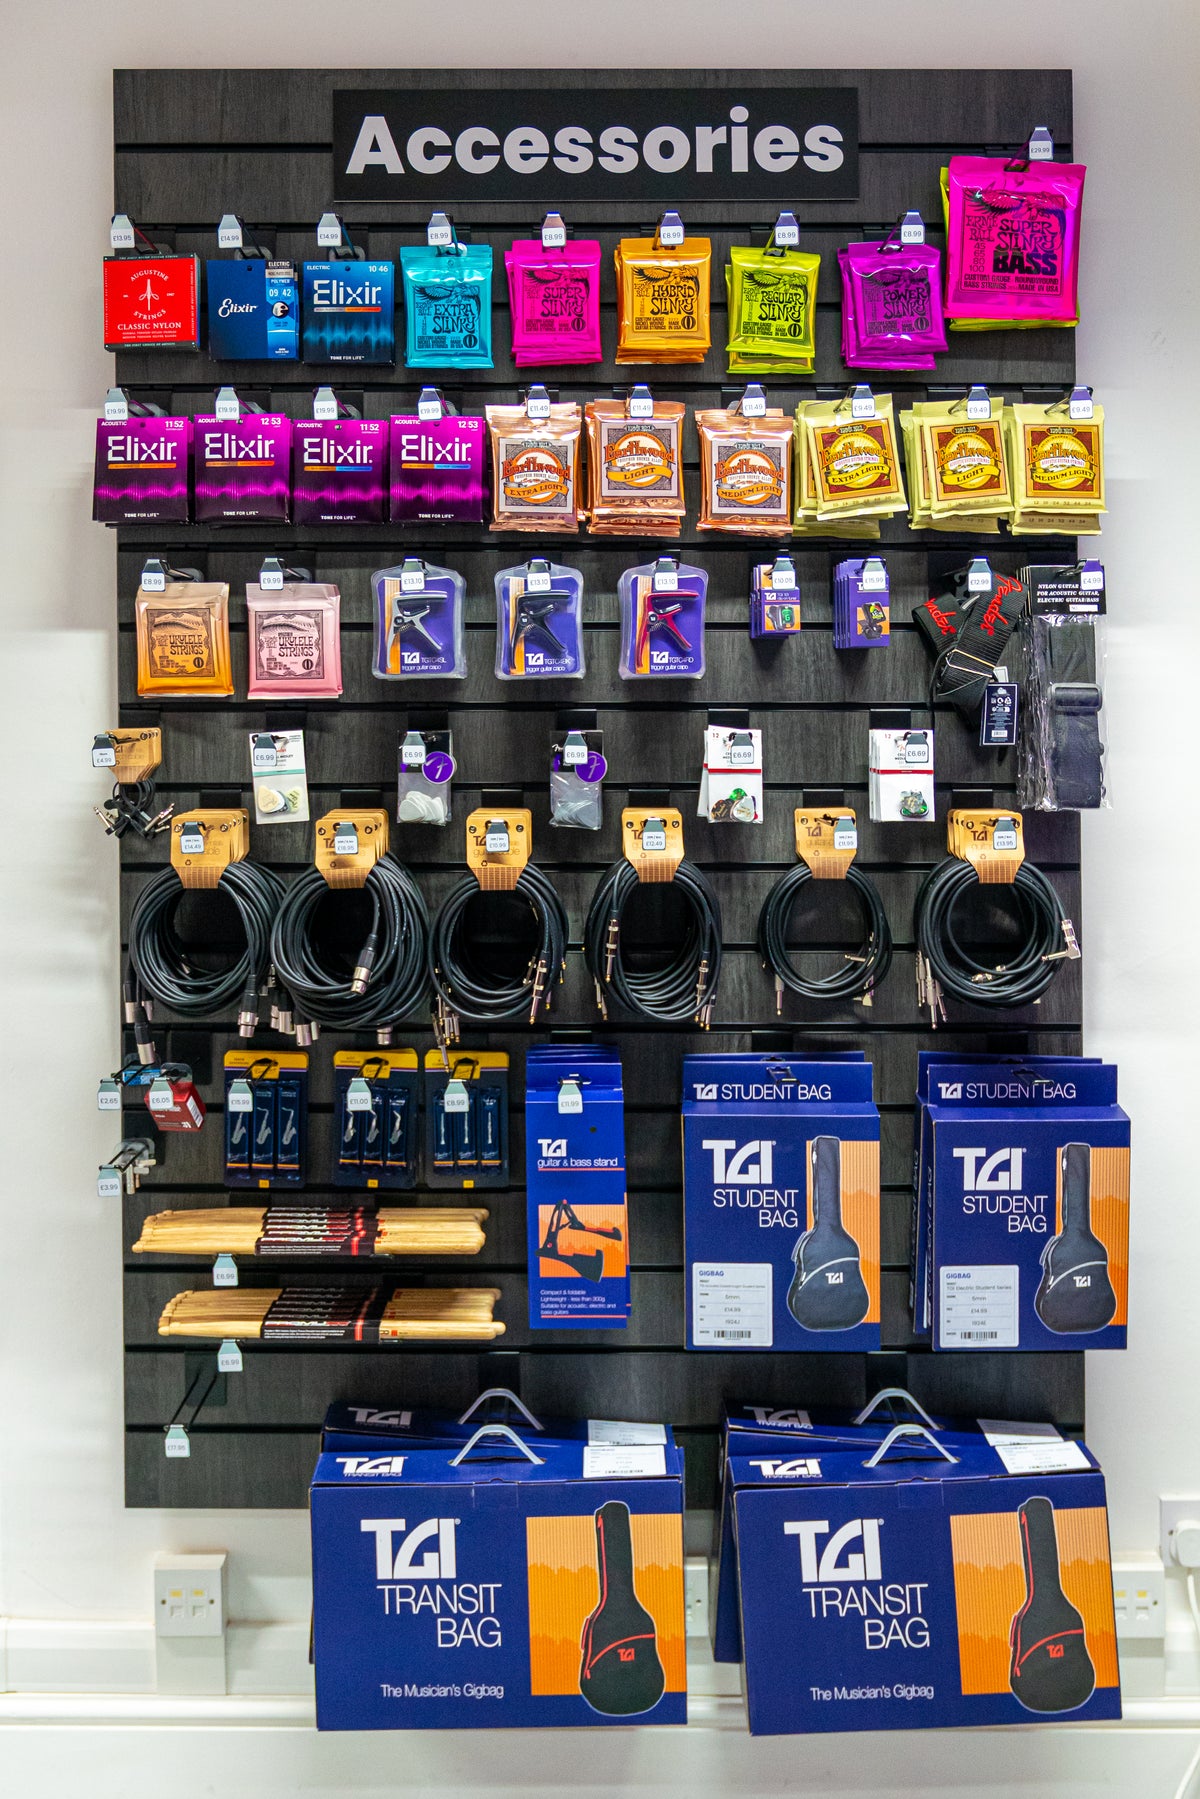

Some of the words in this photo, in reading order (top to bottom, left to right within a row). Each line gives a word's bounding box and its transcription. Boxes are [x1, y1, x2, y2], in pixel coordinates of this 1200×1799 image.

[347, 106, 845, 174] Accessories
[999, 219, 1054, 234] SUPER
[113, 234, 131, 242] £13.95
[430, 232, 448, 240] £8.99
[544, 233, 563, 241] £8.99
[662, 232, 681, 240] £8.99
[904, 230, 922, 238] £8.99
[993, 251, 1057, 274] BASS
[130, 269, 169, 282] AUGUSTINE
[964, 274, 988, 282] CUSTOM
[269, 288, 278, 297] 09
[282, 288, 291, 297] 42
[543, 286, 583, 300] SUPER
[882, 288, 926, 302] POWER
[1046, 284, 1059, 292] USA
[761, 291, 804, 306] REGULAR
[133, 308, 167, 320] STRINGS
[218, 298, 258, 318] Elixir
[434, 303, 474, 317] EXTRA
[624, 466, 656, 480] LIGHT
[831, 470, 857, 486] EXTRA
[857, 468, 885, 480] LIGHT
[957, 467, 985, 483] LIGHT
[1034, 472, 1067, 481] MEDIUM
[1069, 469, 1093, 479] LIGHT
[509, 487, 538, 498] EXTRA
[540, 485, 563, 494] LIGHT
[721, 487, 755, 498] MEDIUM
[756, 486, 781, 496] LIGHT
[169, 634, 203, 645] UKULELE
[279, 636, 313, 646] UKULELE
[170, 645, 204, 656] STRINGS
[278, 646, 313, 657] STRINGS
[733, 751, 752, 759] £6.69
[907, 750, 926, 758] £6.69
[722, 1084, 794, 1100] STUDENT
[798, 1085, 831, 1100] BAG
[966, 1083, 1038, 1099] STUDENT
[1044, 1083, 1076, 1099] BAG
[538, 1158, 561, 1168] guitar
[570, 1158, 592, 1167] bass
[593, 1158, 618, 1166] stand
[713, 1190, 798, 1208] STUDENT
[963, 1196, 1048, 1214] STUDENT
[759, 1210, 798, 1228] BAG
[1008, 1215, 1047, 1233] BAG
[376, 1584, 502, 1614] TRANSIT
[802, 1583, 929, 1618] TRANSIT
[437, 1618, 502, 1648] BAG
[865, 1617, 931, 1650] BAG
[381, 1684, 402, 1697] The
[403, 1684, 462, 1697] Musician's
[464, 1684, 504, 1699] Gigbag
[810, 1686, 831, 1700] The
[833, 1685, 891, 1700] Musician's
[893, 1684, 934, 1700] Gigbag
